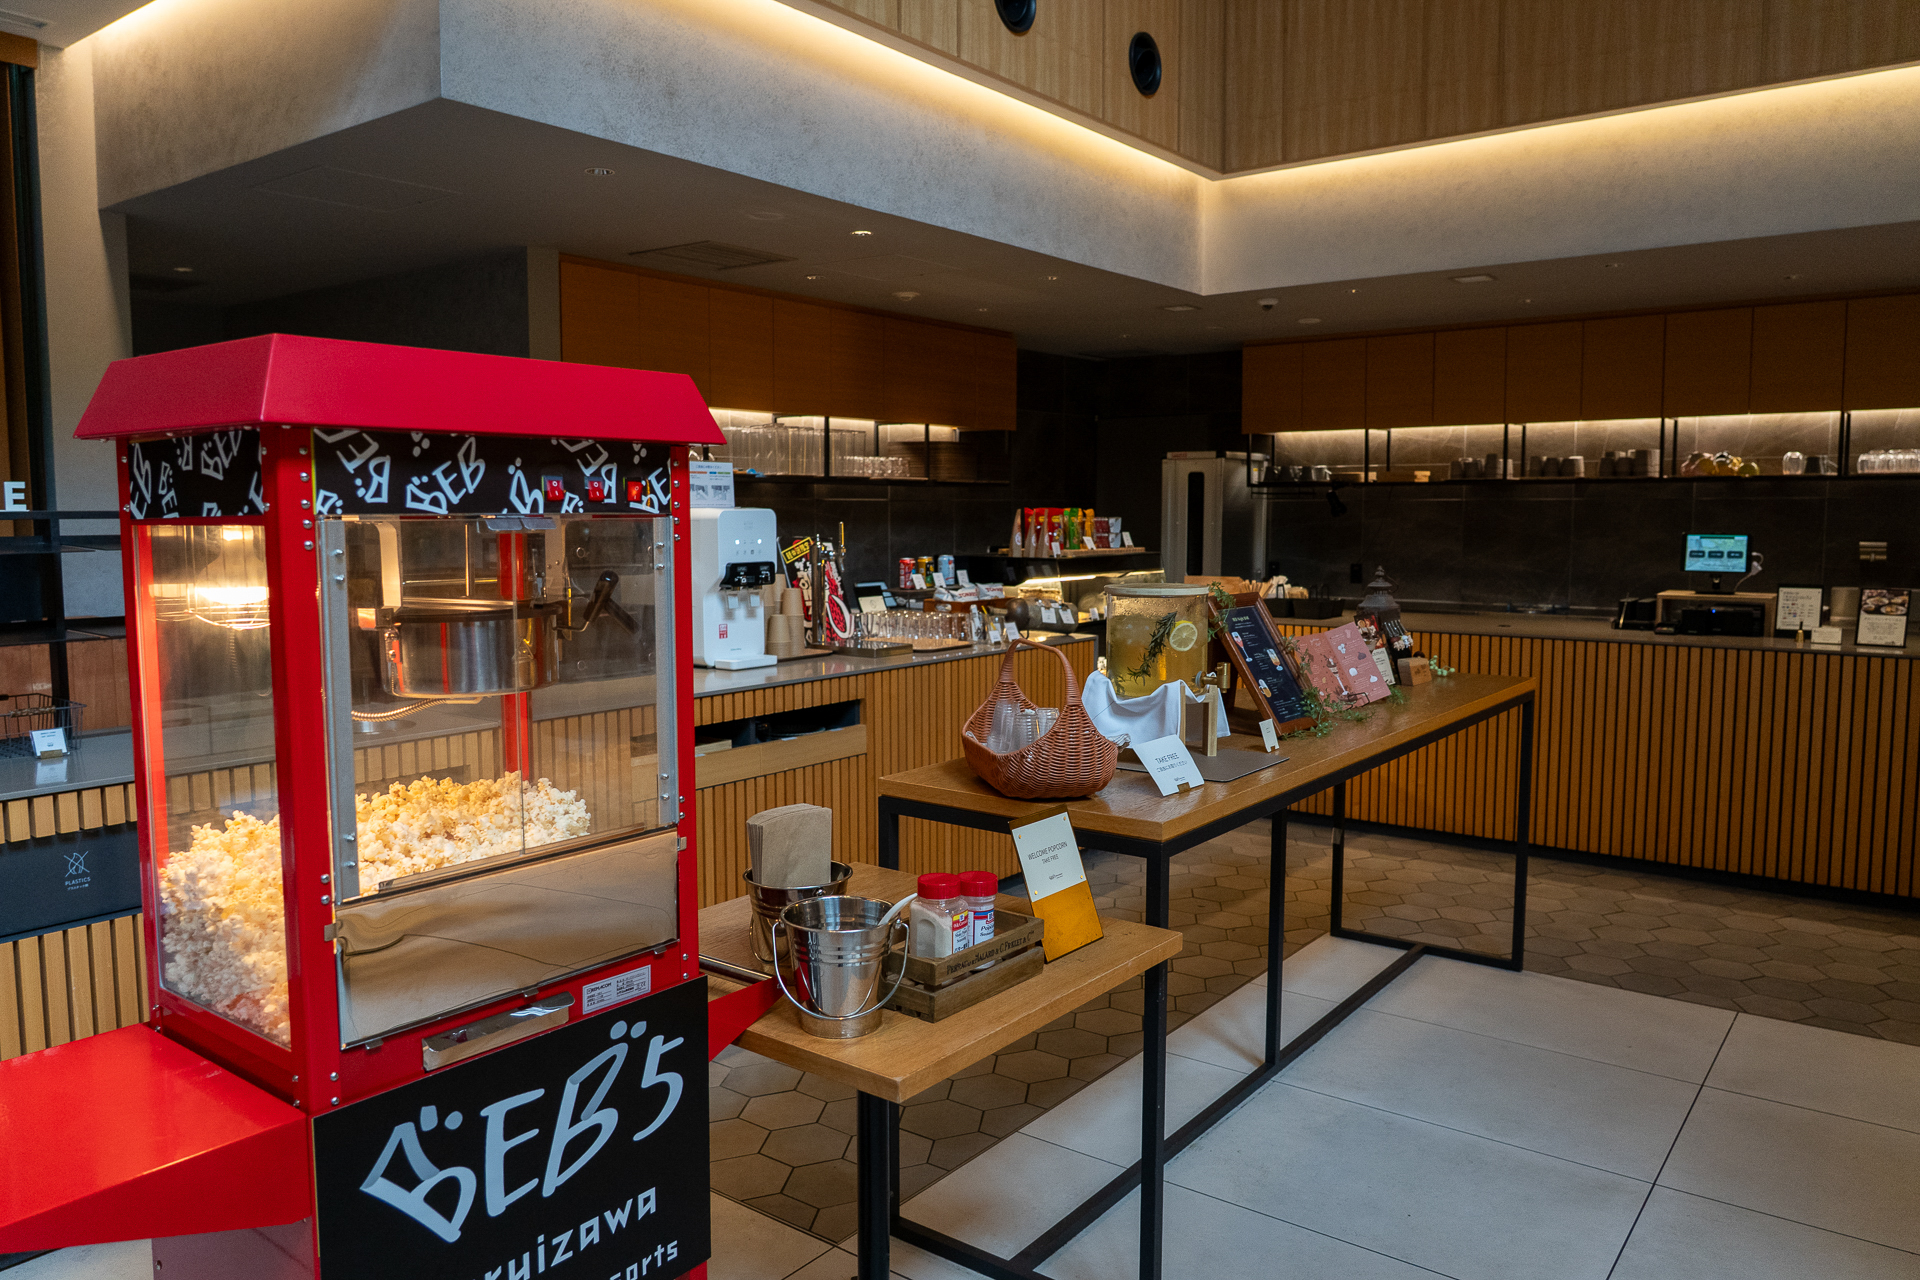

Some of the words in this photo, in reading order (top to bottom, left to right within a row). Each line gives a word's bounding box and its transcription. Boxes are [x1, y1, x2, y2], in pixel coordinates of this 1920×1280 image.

[405, 436, 486, 515] BEB
[1027, 847, 1049, 860] WELCOME
[1048, 841, 1068, 854] POPCORN
[65, 877, 91, 886] PLASTICS
[359, 1020, 684, 1243] BEB5
